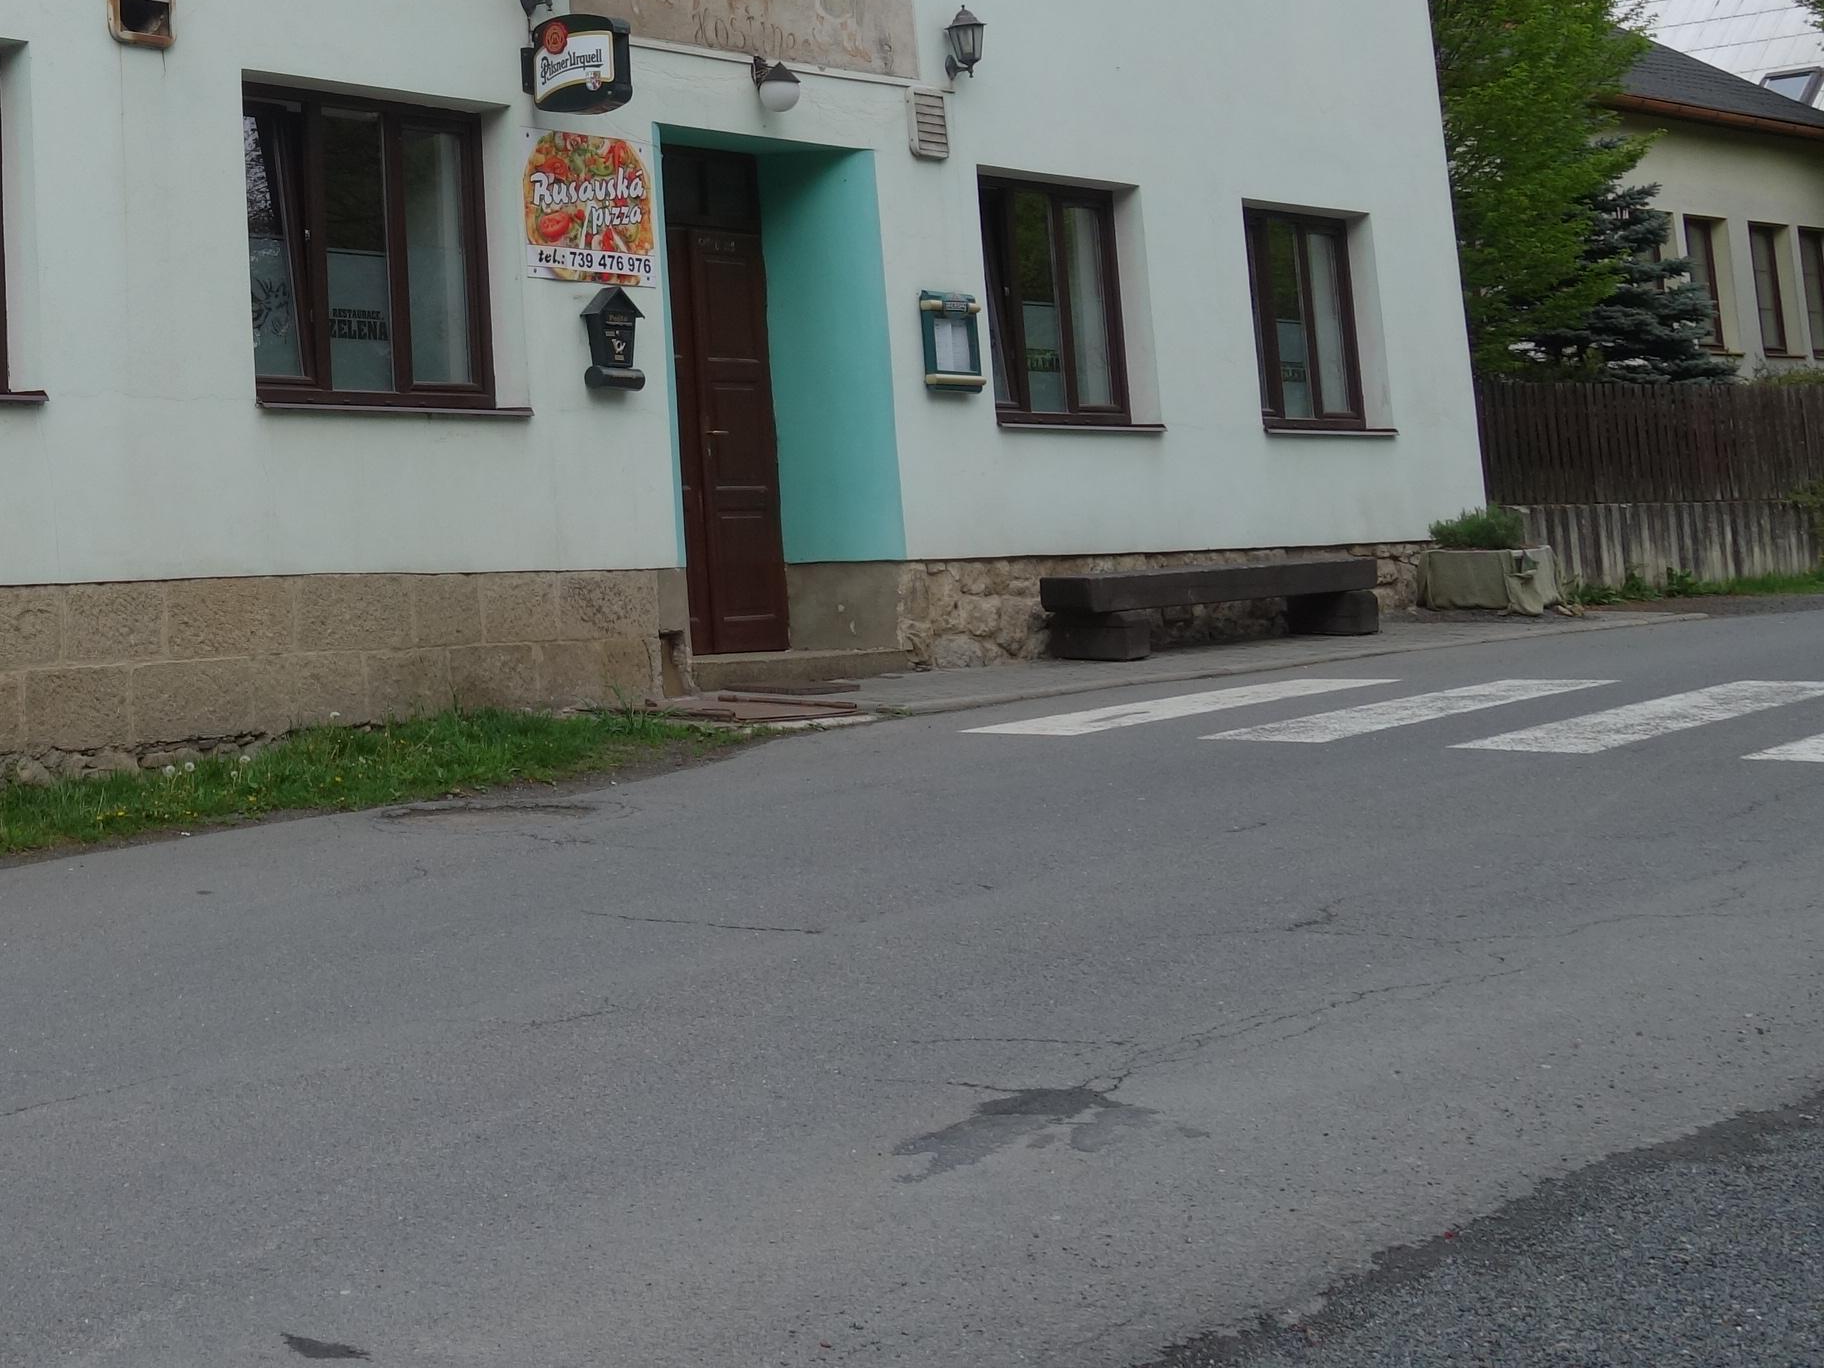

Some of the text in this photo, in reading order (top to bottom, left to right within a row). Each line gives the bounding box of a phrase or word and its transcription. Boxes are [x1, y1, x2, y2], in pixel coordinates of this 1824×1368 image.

[540, 48, 603, 85] Pilsner Urquell
[530, 167, 646, 206] Rusavská
[591, 200, 643, 235] pizza
[538, 249, 652, 274] tel.: 739 476 976
